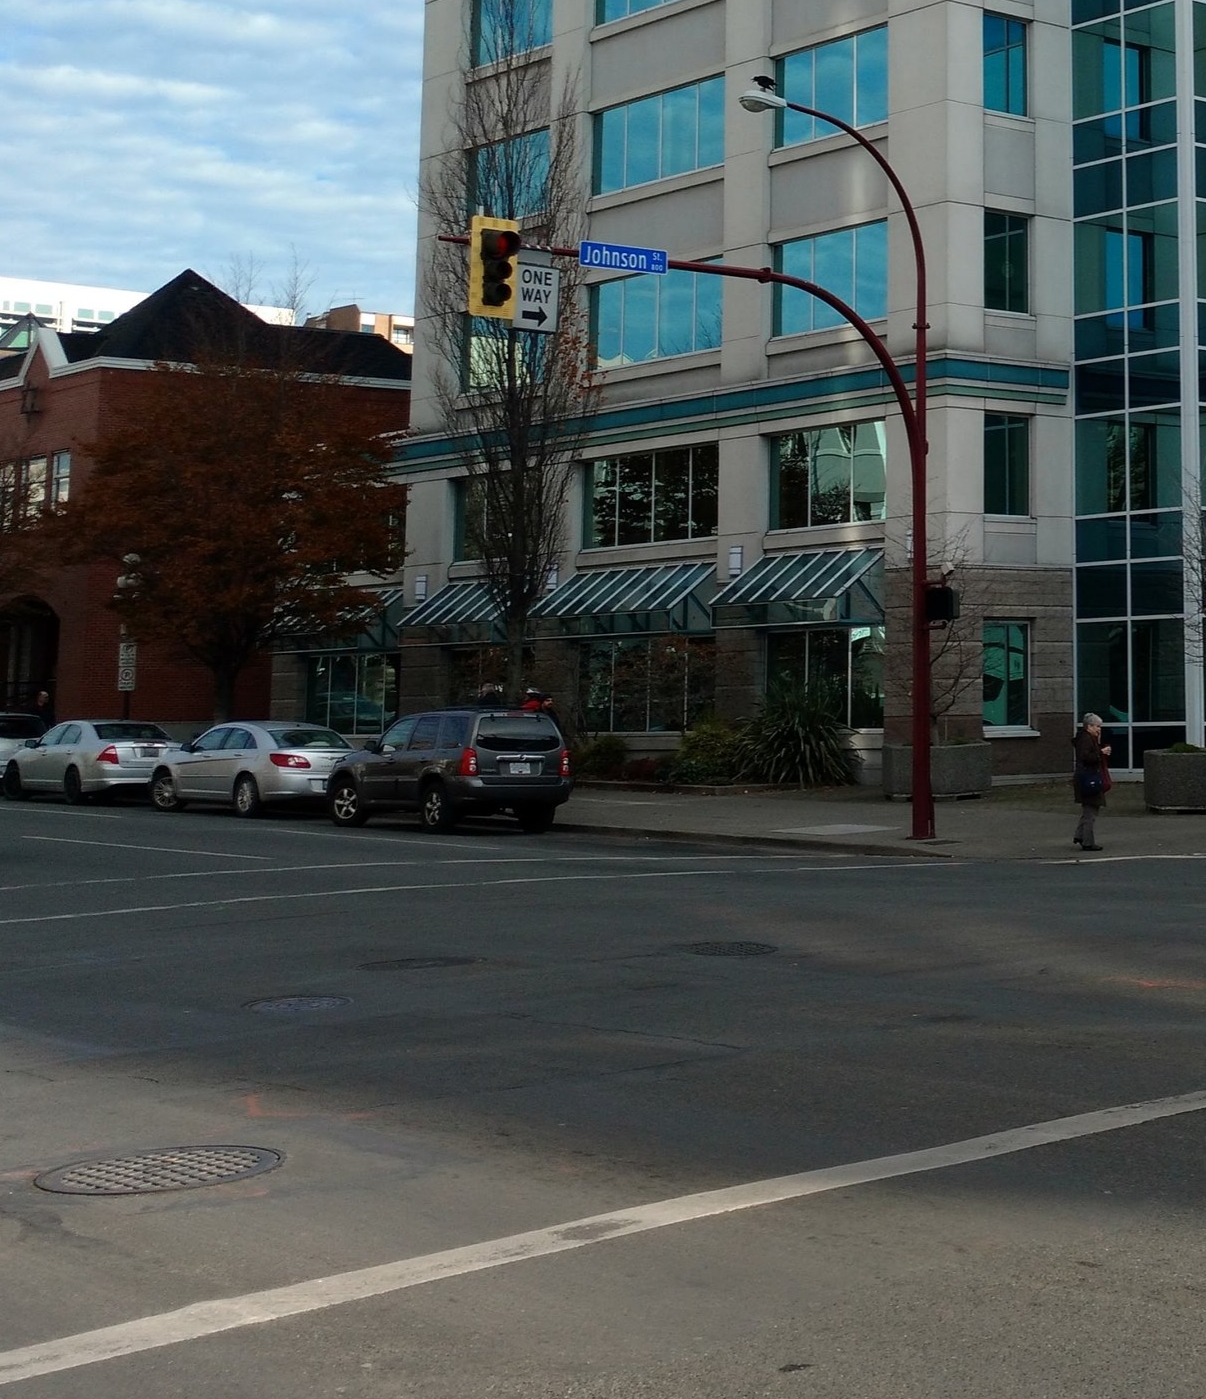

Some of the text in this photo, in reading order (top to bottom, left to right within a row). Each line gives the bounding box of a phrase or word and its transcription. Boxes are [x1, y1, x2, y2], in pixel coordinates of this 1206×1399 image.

[583, 245, 663, 270] Johnson St.
[651, 264, 663, 272] 800
[521, 269, 553, 287] ONE
[521, 287, 552, 304] WAY
